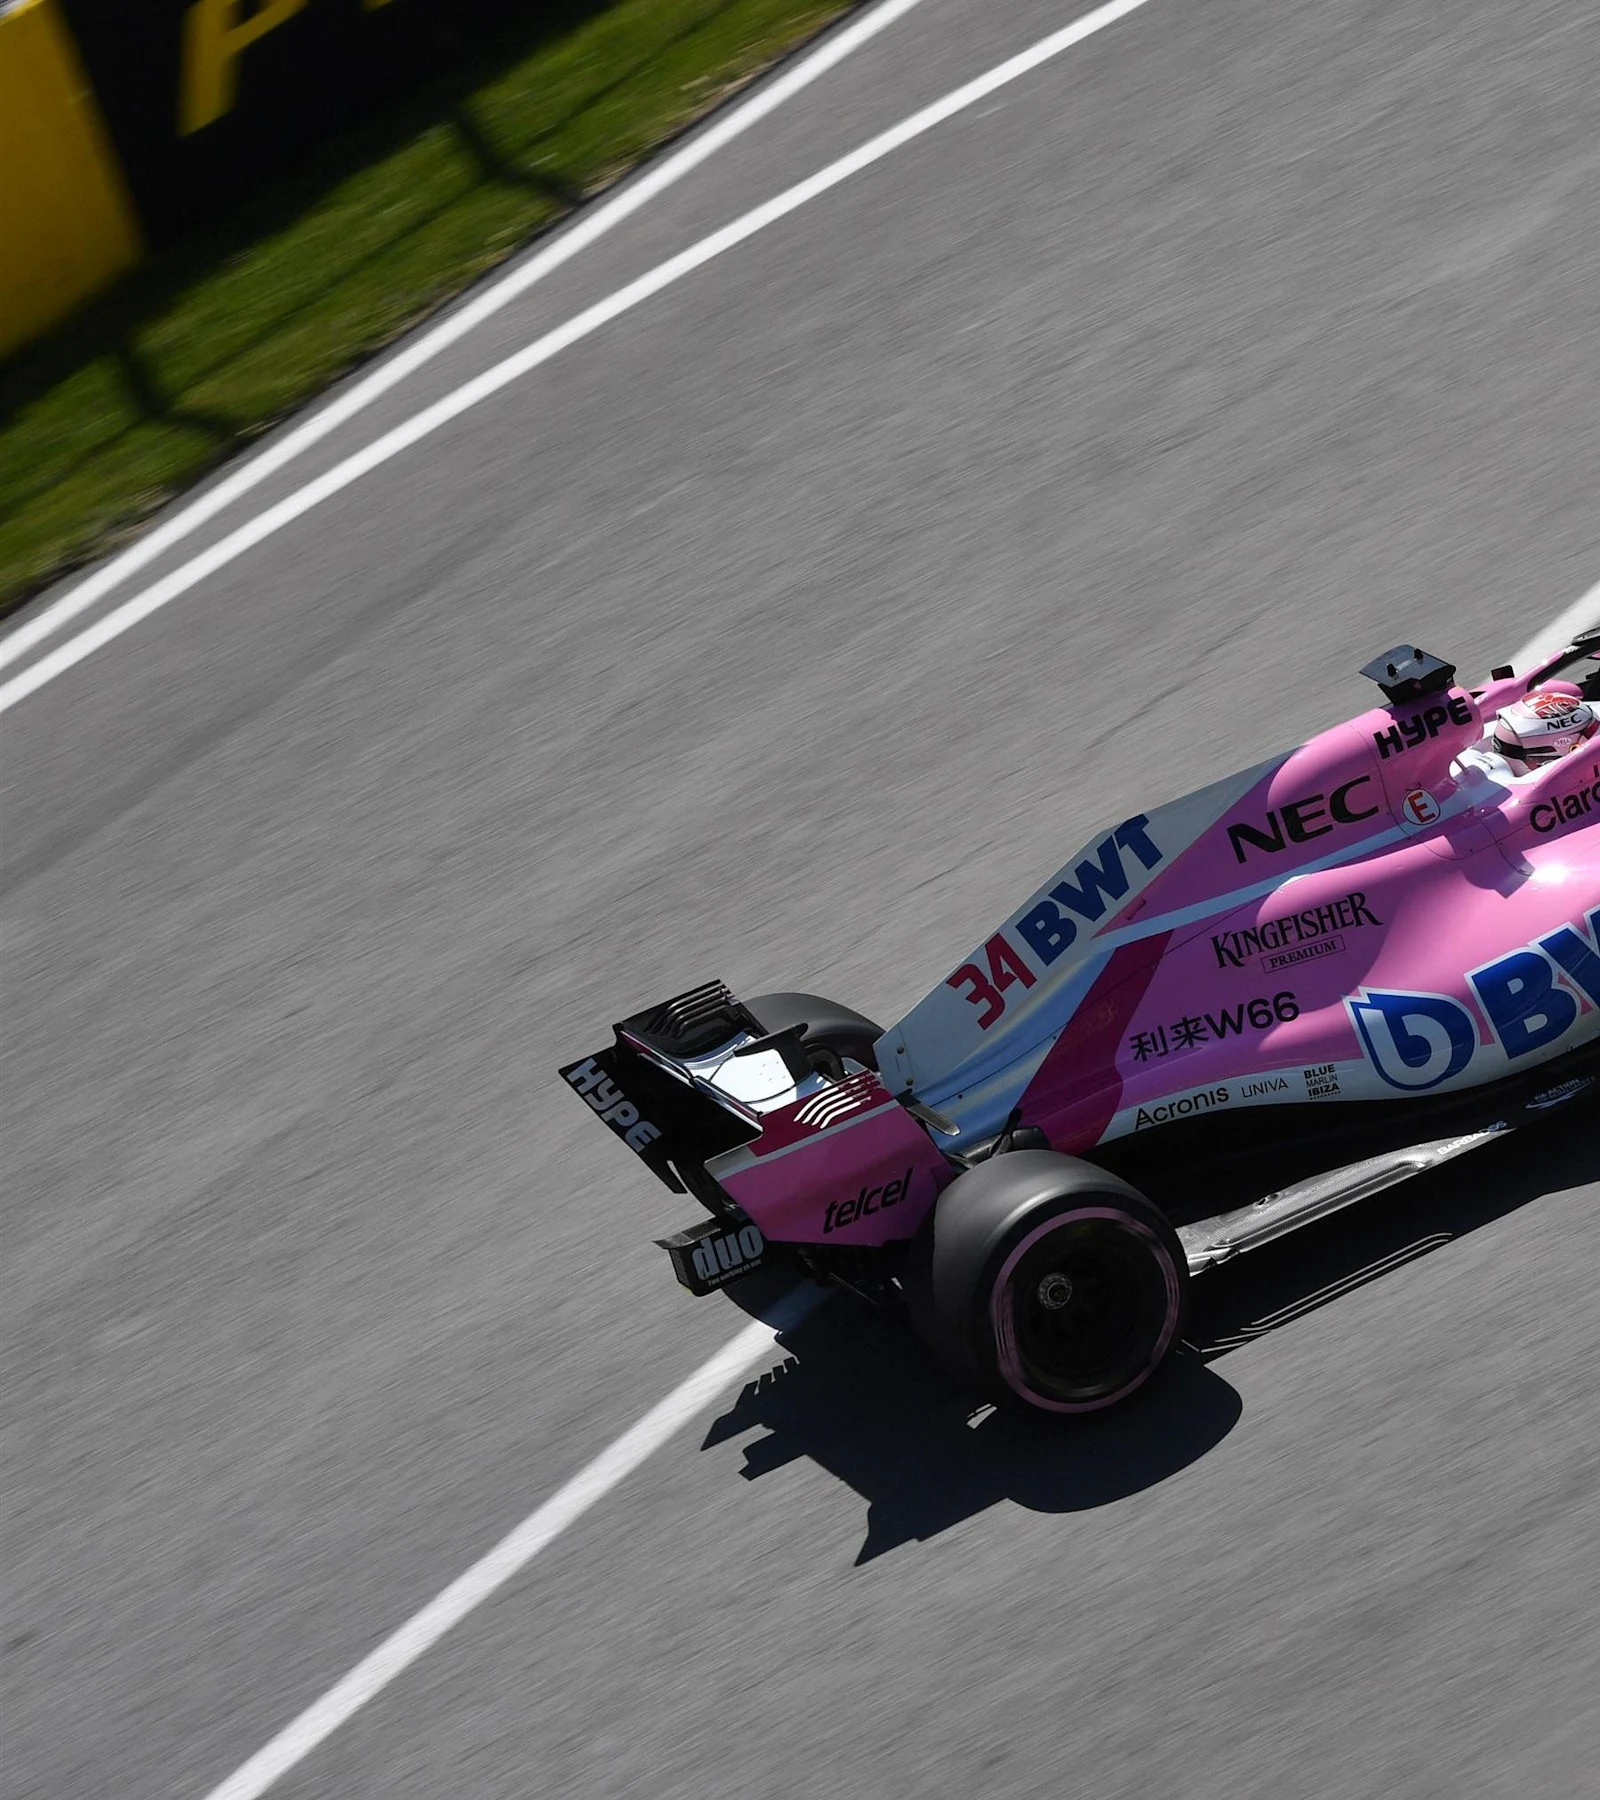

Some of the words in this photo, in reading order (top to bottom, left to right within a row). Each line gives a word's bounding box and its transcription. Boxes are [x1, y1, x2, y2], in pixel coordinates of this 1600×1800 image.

[1373, 697, 1473, 759] HYPE
[1546, 713, 1582, 731] NEC
[1226, 776, 1380, 864] NEC
[1405, 791, 1436, 826] E
[945, 932, 1038, 1031] 34
[1015, 812, 1164, 967] BWT
[1210, 891, 1384, 969] KINGFISHER
[1270, 940, 1338, 969] PREMIUM
[1129, 991, 1301, 1063] 利来W66
[1303, 1063, 1336, 1079] BLUE
[1306, 1073, 1338, 1088] MARLIN
[1308, 1082, 1341, 1097] IBIZA
[567, 1057, 663, 1153] HYPE
[1134, 1086, 1230, 1131] Acronis
[1241, 1077, 1289, 1099] UNIVA
[822, 1167, 914, 1234] telcel
[692, 1225, 765, 1280] duo
